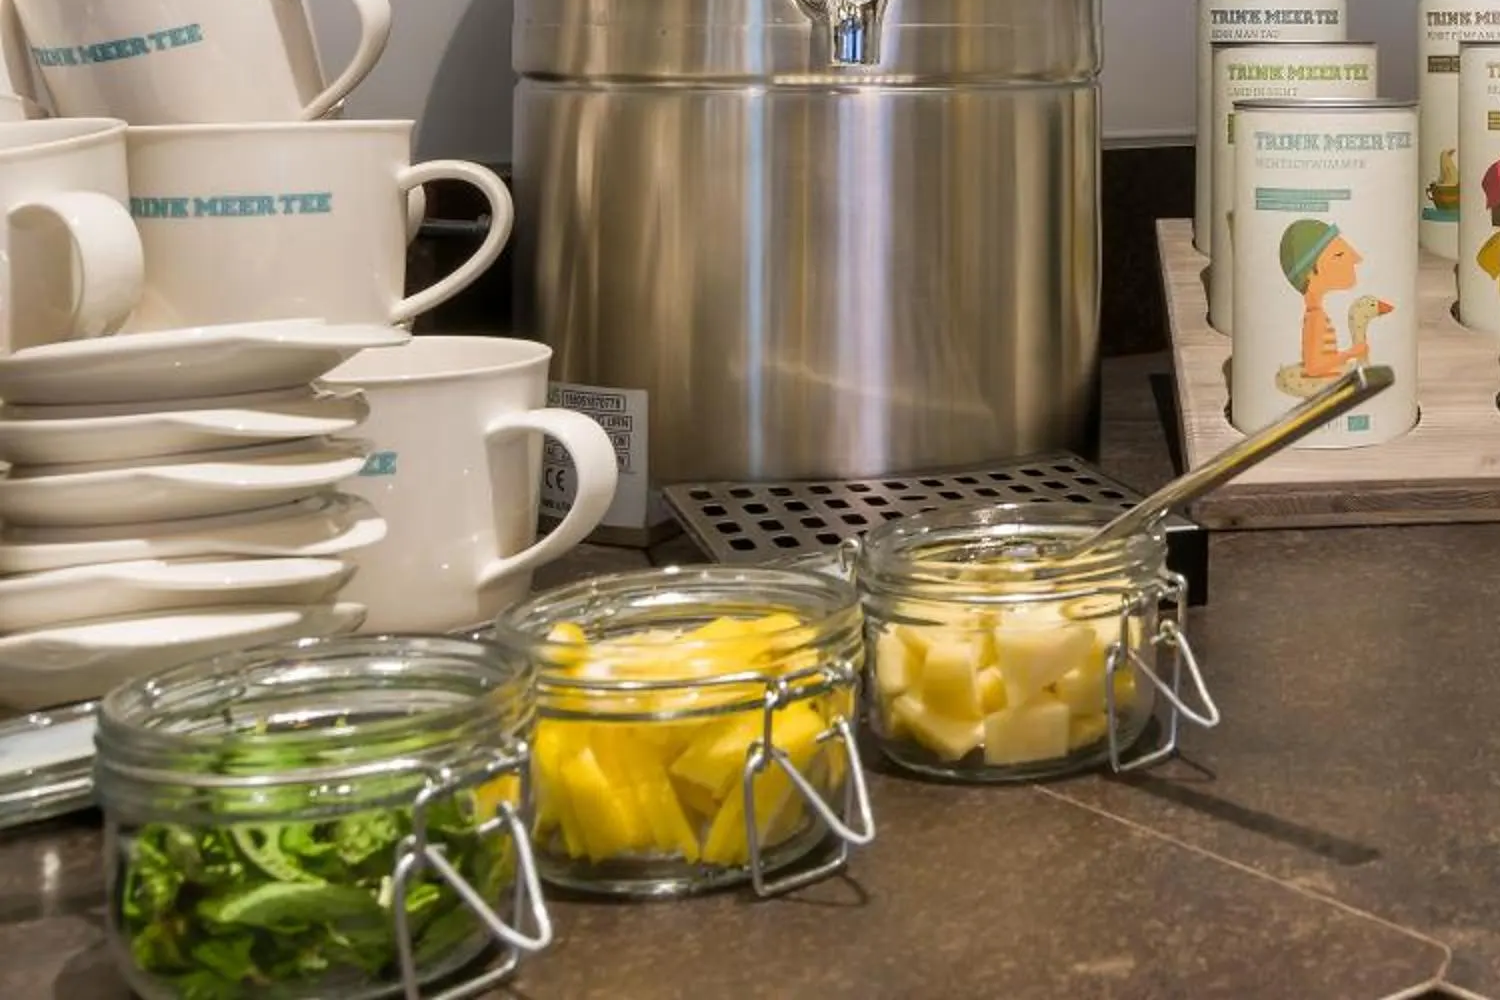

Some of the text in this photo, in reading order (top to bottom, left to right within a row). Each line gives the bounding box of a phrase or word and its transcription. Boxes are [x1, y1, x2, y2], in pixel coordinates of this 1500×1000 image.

[1211, 9, 1262, 25] TRINK
[1264, 9, 1315, 25] MEER
[1426, 11, 1472, 27] TRINK
[32, 24, 203, 66] RINK MEER TEE
[1255, 131, 1320, 151] TRINK
[1323, 132, 1383, 151] MEER
[130, 193, 332, 219] RINK MEER TEE
